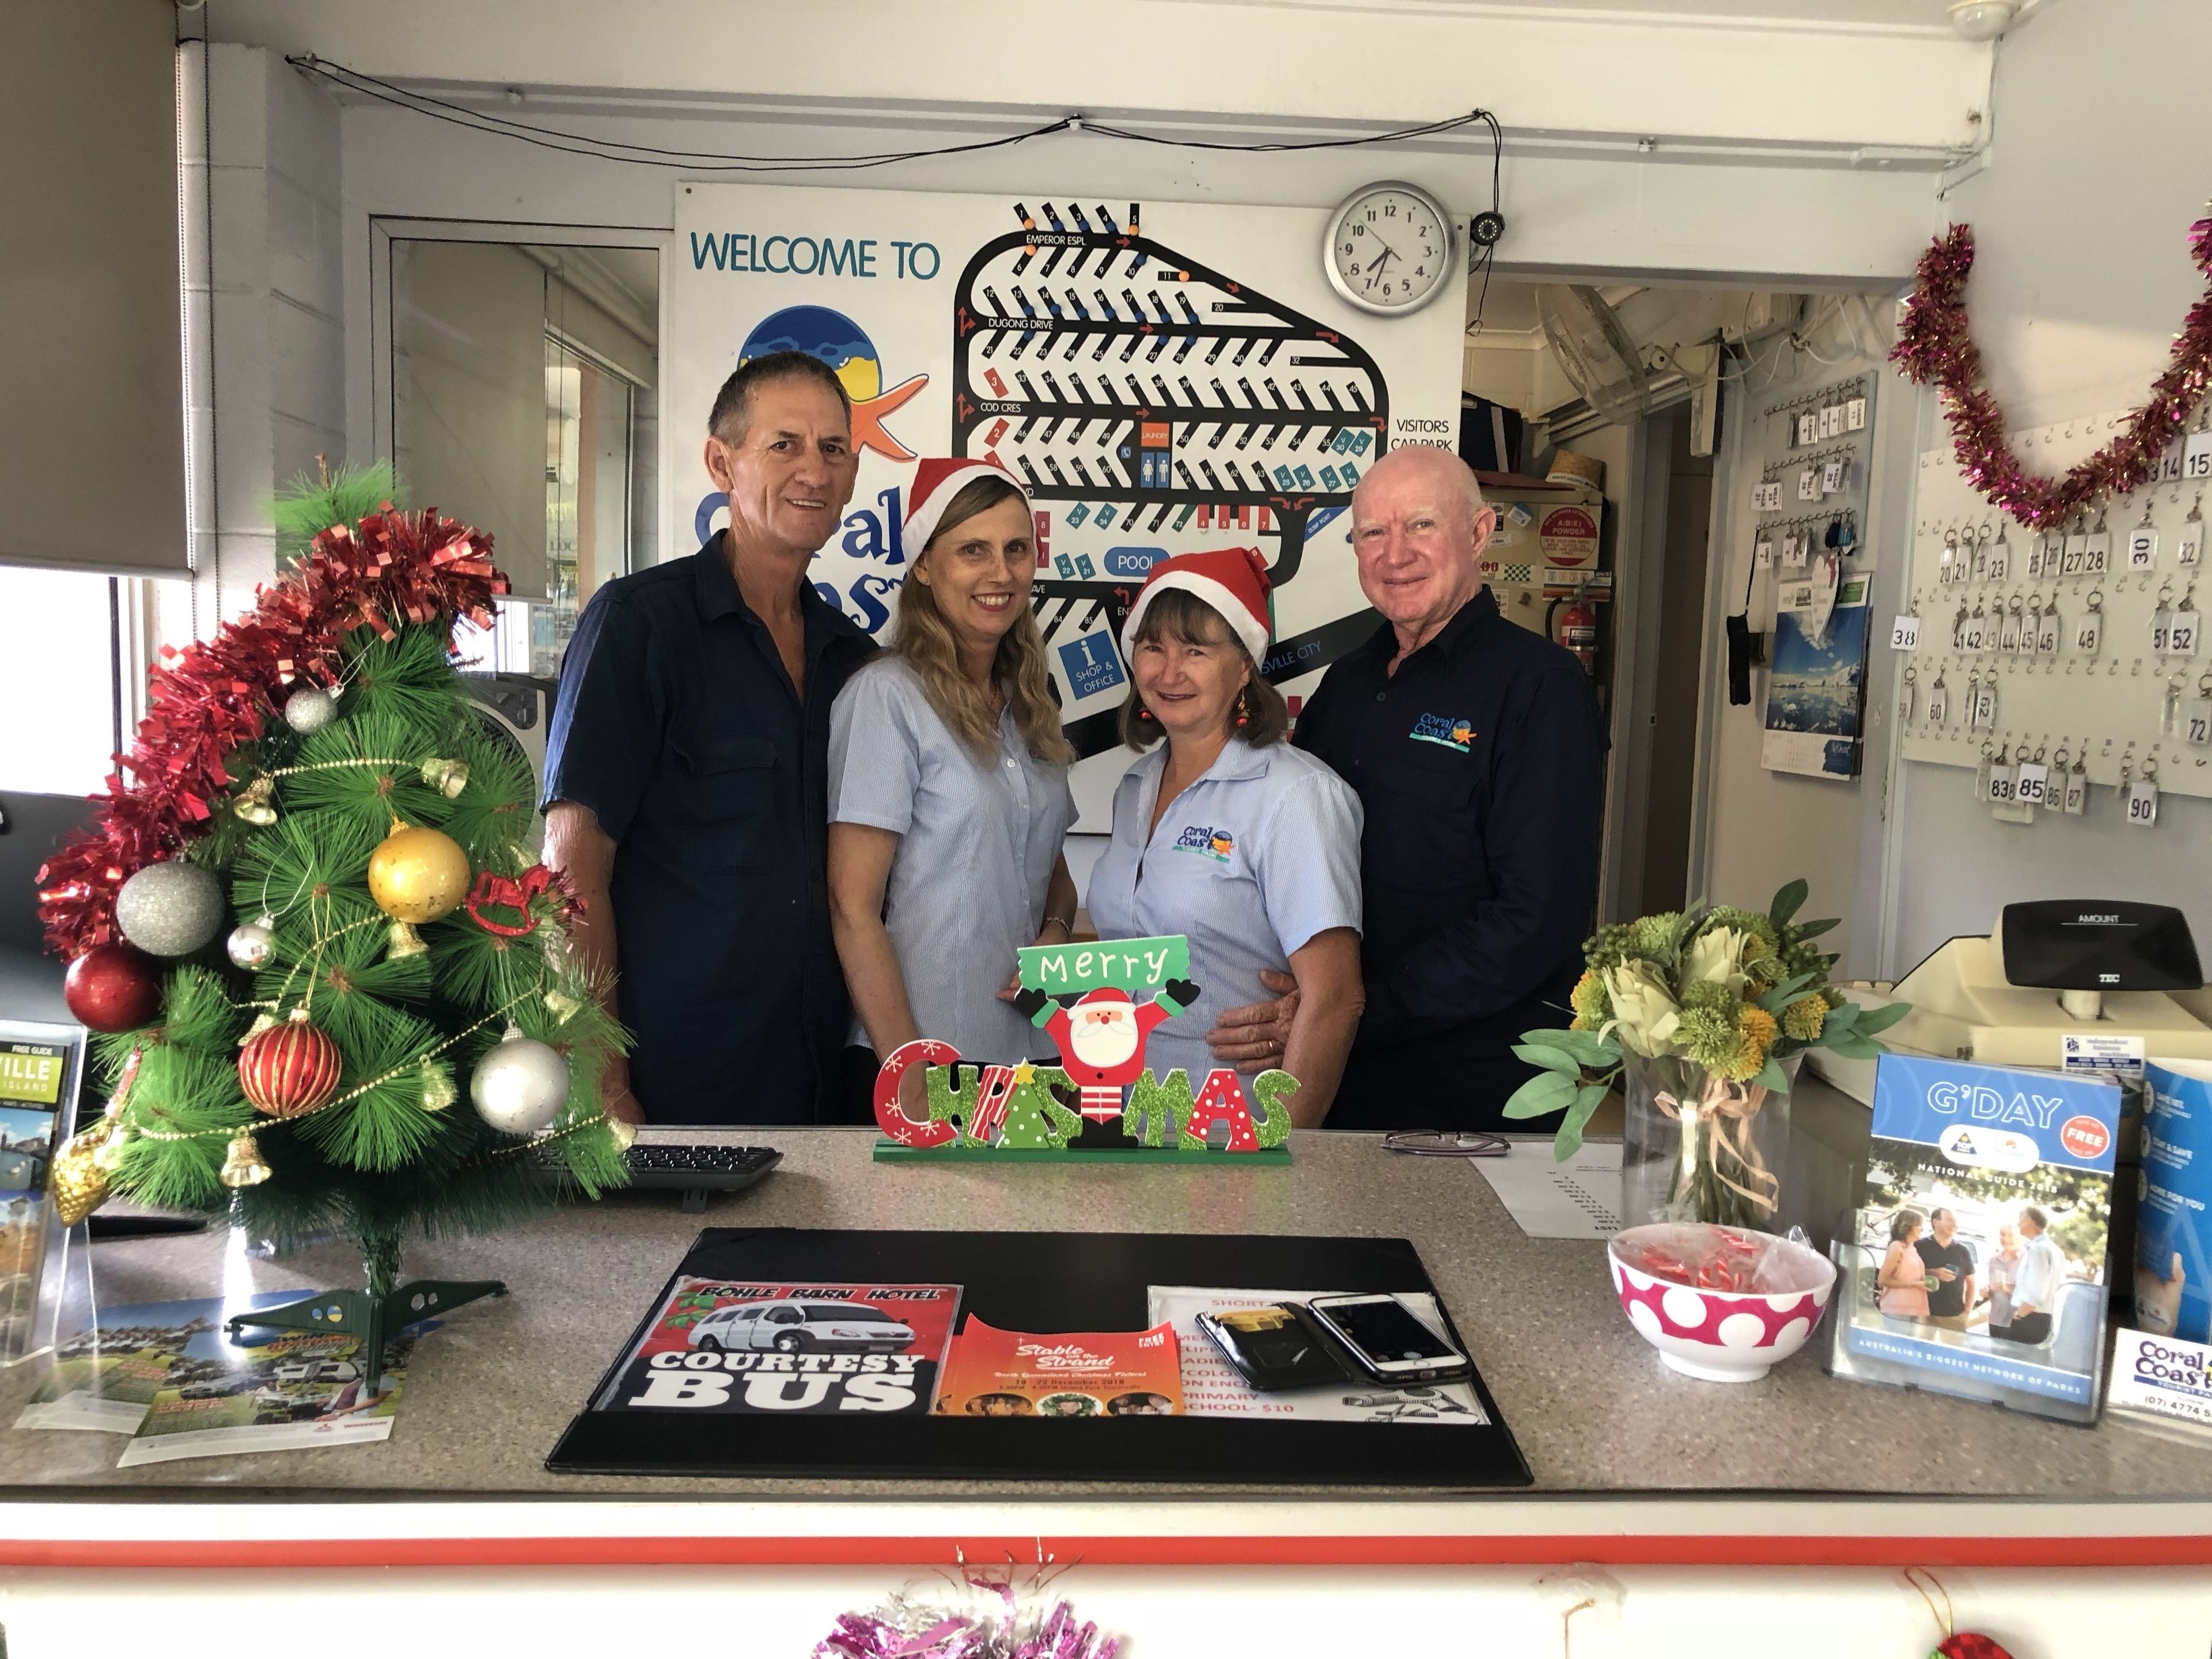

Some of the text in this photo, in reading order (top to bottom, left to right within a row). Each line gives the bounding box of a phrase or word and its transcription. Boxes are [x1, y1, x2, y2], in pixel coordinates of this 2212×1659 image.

[1367, 211, 1376, 221] 11
[1385, 206, 1396, 216] 12
[1407, 211, 1412, 223] 1
[1352, 226, 1364, 236] 10
[1419, 226, 1426, 237] 2
[1027, 235, 1065, 245] EMPEROR
[1345, 244, 1353, 255] 9
[1423, 247, 1431, 257] 3
[691, 232, 940, 280] WELCOME TO
[1350, 264, 1359, 275] 8
[1415, 266, 1424, 276] 4
[1364, 279, 1372, 289] 7
[1383, 283, 1391, 296] 6
[1402, 280, 1410, 291] 5
[986, 289, 994, 298] 12
[1014, 289, 1022, 298] 13
[1042, 291, 1049, 299] 14
[1069, 292, 1075, 301] 15
[1097, 293, 1104, 302] 16
[1126, 295, 1132, 303] 17
[1215, 304, 1224, 312] 20
[988, 319, 1053, 329] DUGONG DRIVE
[986, 346, 993, 354] 21
[1014, 347, 1022, 355] 22
[1039, 348, 1048, 357] 23
[1095, 350, 1103, 358] 25
[1149, 351, 1158, 360] 27
[1176, 352, 1184, 361] 28
[1236, 355, 1244, 363] 30
[1018, 374, 1027, 382] 33
[1045, 376, 1054, 384] 34
[1100, 377, 1109, 385] 36
[1154, 380, 1164, 388] 38
[1213, 381, 1222, 389] 40
[1241, 381, 1248, 389] 41
[1267, 382, 1275, 391] 42
[981, 403, 1021, 413] COD CRES
[1397, 419, 1449, 433] VISITORS
[1102, 433, 1110, 441] 49
[2164, 457, 2177, 477] 14
[2189, 453, 2210, 475] 15
[2133, 538, 2149, 564] 30
[2066, 553, 2082, 571] 27
[2086, 551, 2103, 570] 28
[1940, 567, 1949, 582] 20
[1955, 564, 1965, 580] 21
[1992, 560, 2003, 578] 23
[1032, 585, 1045, 593] AVE
[1954, 633, 1963, 649] 41
[1967, 631, 1981, 649] 42
[2040, 633, 2052, 650] 46
[2078, 630, 2094, 649] 48
[2154, 628, 2167, 649] 51
[2173, 628, 2191, 649] 52
[1297, 641, 1321, 659] CITY
[1076, 661, 1113, 681] SHOP &
[1084, 674, 1115, 692] OFFICE
[1930, 704, 1941, 719] 60
[1421, 713, 1455, 729] Coral
[1415, 723, 1453, 739] Coast
[2190, 719, 2205, 741] 72
[1992, 780, 2008, 797] 83
[2020, 779, 2044, 798] 85
[2131, 798, 2151, 819] 90
[1184, 826, 1213, 838] Coral
[1177, 836, 1213, 850] Coast
[2078, 915, 2120, 923] AMOUNT
[1040, 948, 1169, 982] Merry
[31, 1047, 52, 1055] GUIDE
[0, 1056, 51, 1080] ILLE
[3, 1080, 47, 1092] ISLAND
[2066, 1128, 2104, 1147] FREE
[1918, 1164, 1981, 1181] NATIONAL
[1984, 1175, 2025, 1188] GUIDE
[698, 1287, 940, 1300] BOHLE BARN HOTEL
[1139, 1332, 1164, 1343] FREE
[1016, 1344, 1085, 1356] Stable
[2139, 1341, 2203, 1370] Coral
[649, 1352, 925, 1372] COURTESY
[1036, 1356, 1115, 1366] Strand
[1926, 1354, 1969, 1369] BIGGEST
[1972, 1364, 2024, 1381] NETWORK
[2046, 1381, 2081, 1394] PARKS
[2136, 1357, 2212, 1389] Coast
[628, 1370, 916, 1412] BUS
[1263, 1404, 1294, 1412] $10
